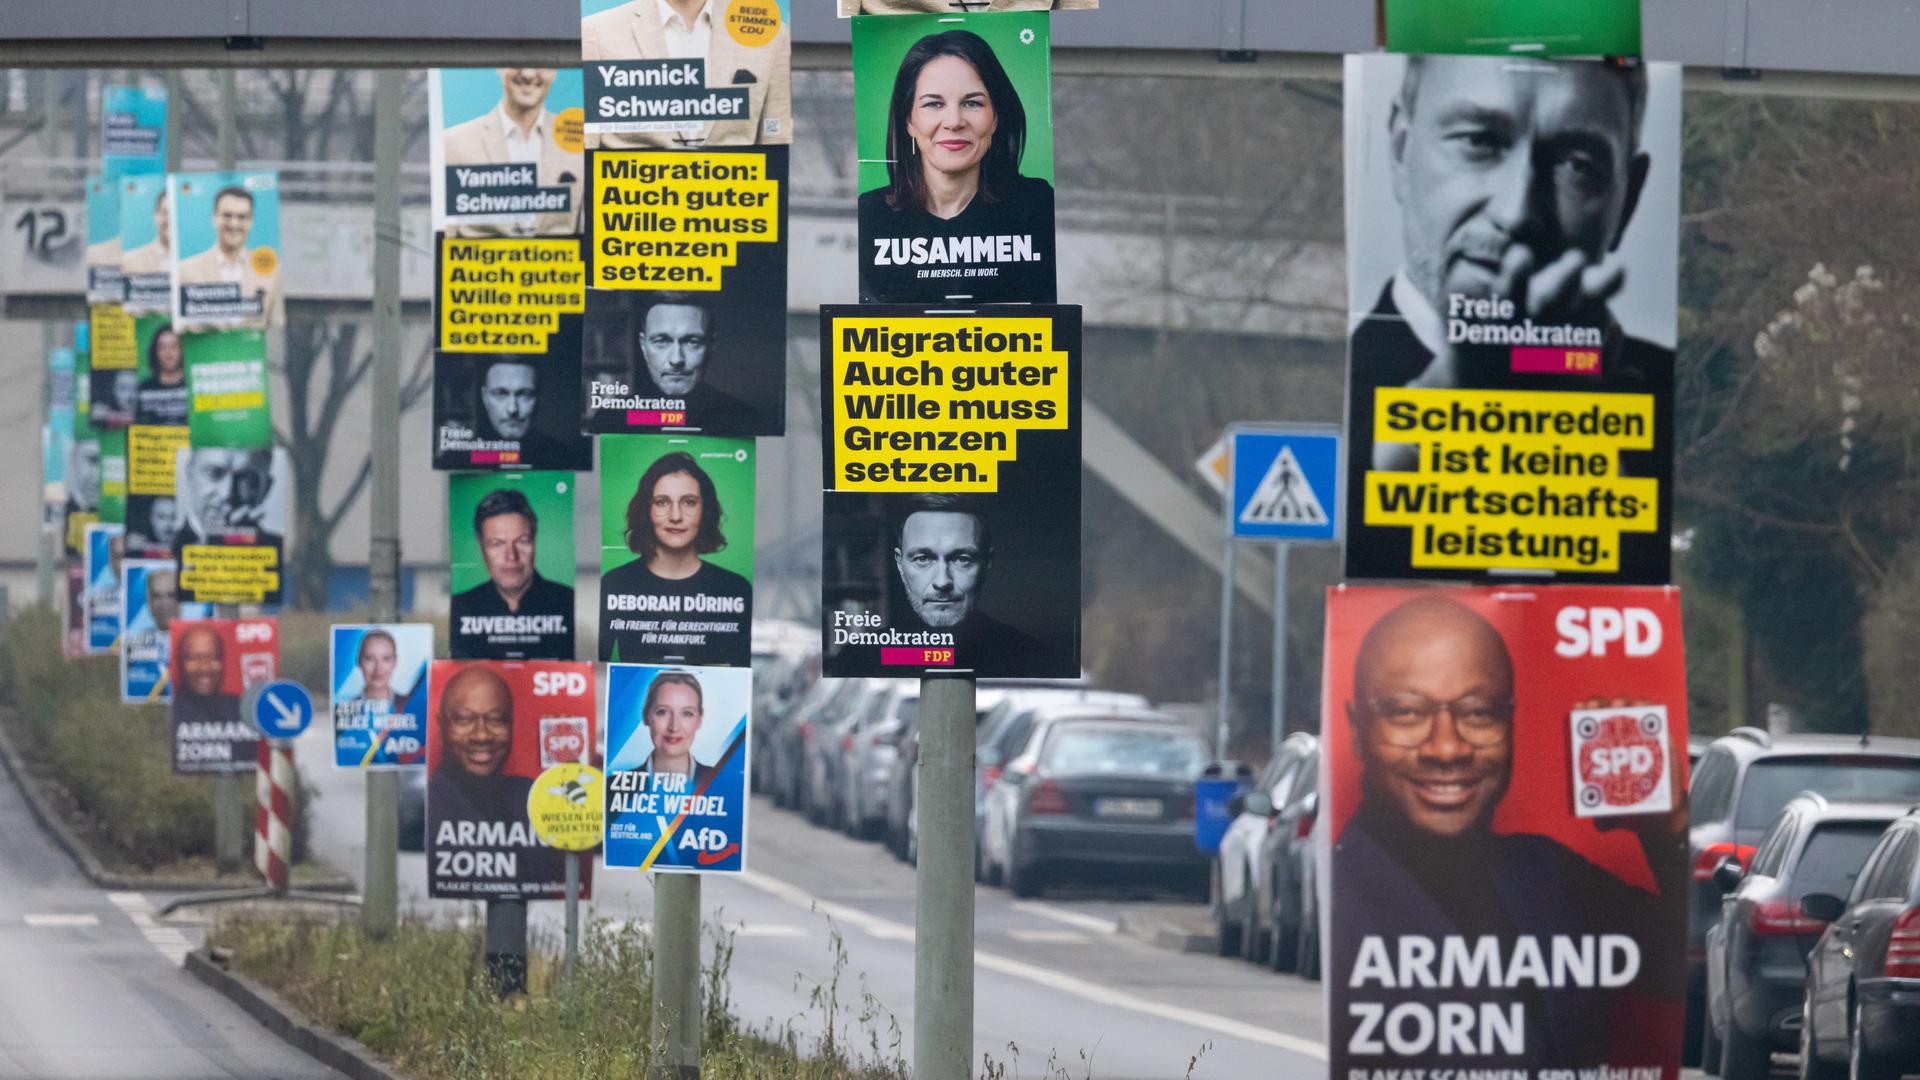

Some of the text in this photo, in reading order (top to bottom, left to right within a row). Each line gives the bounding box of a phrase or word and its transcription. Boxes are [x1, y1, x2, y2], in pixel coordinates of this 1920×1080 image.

[730, 14, 777, 26] STIMMEN
[740, 6, 768, 16] BEIDE
[740, 26, 765, 35] CDU
[598, 64, 699, 88] Yannick
[598, 94, 743, 118] Schwander
[456, 167, 534, 188] Yannick
[601, 160, 758, 183] Migration:
[456, 192, 567, 212] Schwander
[602, 186, 769, 209] Auch guter
[603, 213, 768, 234] Wille muss
[450, 245, 573, 264] Migration:
[601, 238, 729, 258] Grenzen
[874, 235, 1041, 266] ZUSAMMEN.
[450, 268, 581, 286] Auch guter
[601, 264, 713, 282] setzen.
[917, 267, 999, 279] EIN MENSCH. EIN WORT.
[450, 289, 580, 306] Wille muss
[1448, 294, 1514, 319] Freie
[450, 310, 552, 326] Grenzen
[450, 331, 541, 346] setzen.
[842, 327, 1042, 357] Migration:
[1448, 320, 1601, 346] Demokraten
[1565, 351, 1598, 370] FDP
[843, 360, 1058, 391] Auch guter
[591, 381, 629, 396] Freie
[591, 395, 686, 410] Demokraten
[844, 394, 1056, 420] Wille muss
[660, 412, 684, 424] FDP
[1387, 401, 1644, 437] Schönreden
[440, 426, 474, 440] Freie
[844, 426, 1007, 451] Grenzen
[440, 438, 520, 450] Demokraten
[1431, 443, 1609, 477] ist keine
[844, 458, 988, 483] setzen.
[1424, 525, 1609, 565] leistung.
[607, 593, 745, 613] DEBORAH DÜRING
[460, 615, 567, 634] ZUVERSICHT.
[610, 618, 739, 633] FÜR FREIHEIT. FÜR GERECHTIGKEIT.
[834, 611, 881, 627] Freie
[641, 632, 706, 645] FÜR FRANKFURT.
[834, 628, 954, 645] Demokraten
[1554, 606, 1663, 658] SPD
[924, 651, 951, 663] FDP
[533, 671, 587, 696] SPD
[1590, 746, 1653, 774] SPD
[610, 770, 687, 793] ZEIT FÜR
[610, 792, 728, 816] ALICE WEIDEL
[541, 813, 582, 821] WIESEN
[547, 824, 599, 833] INSEKTEN
[678, 827, 728, 851] AfD
[435, 851, 517, 878] ZORN
[1348, 933, 1641, 989] ARMAND
[1348, 1001, 1525, 1056] ZORN
